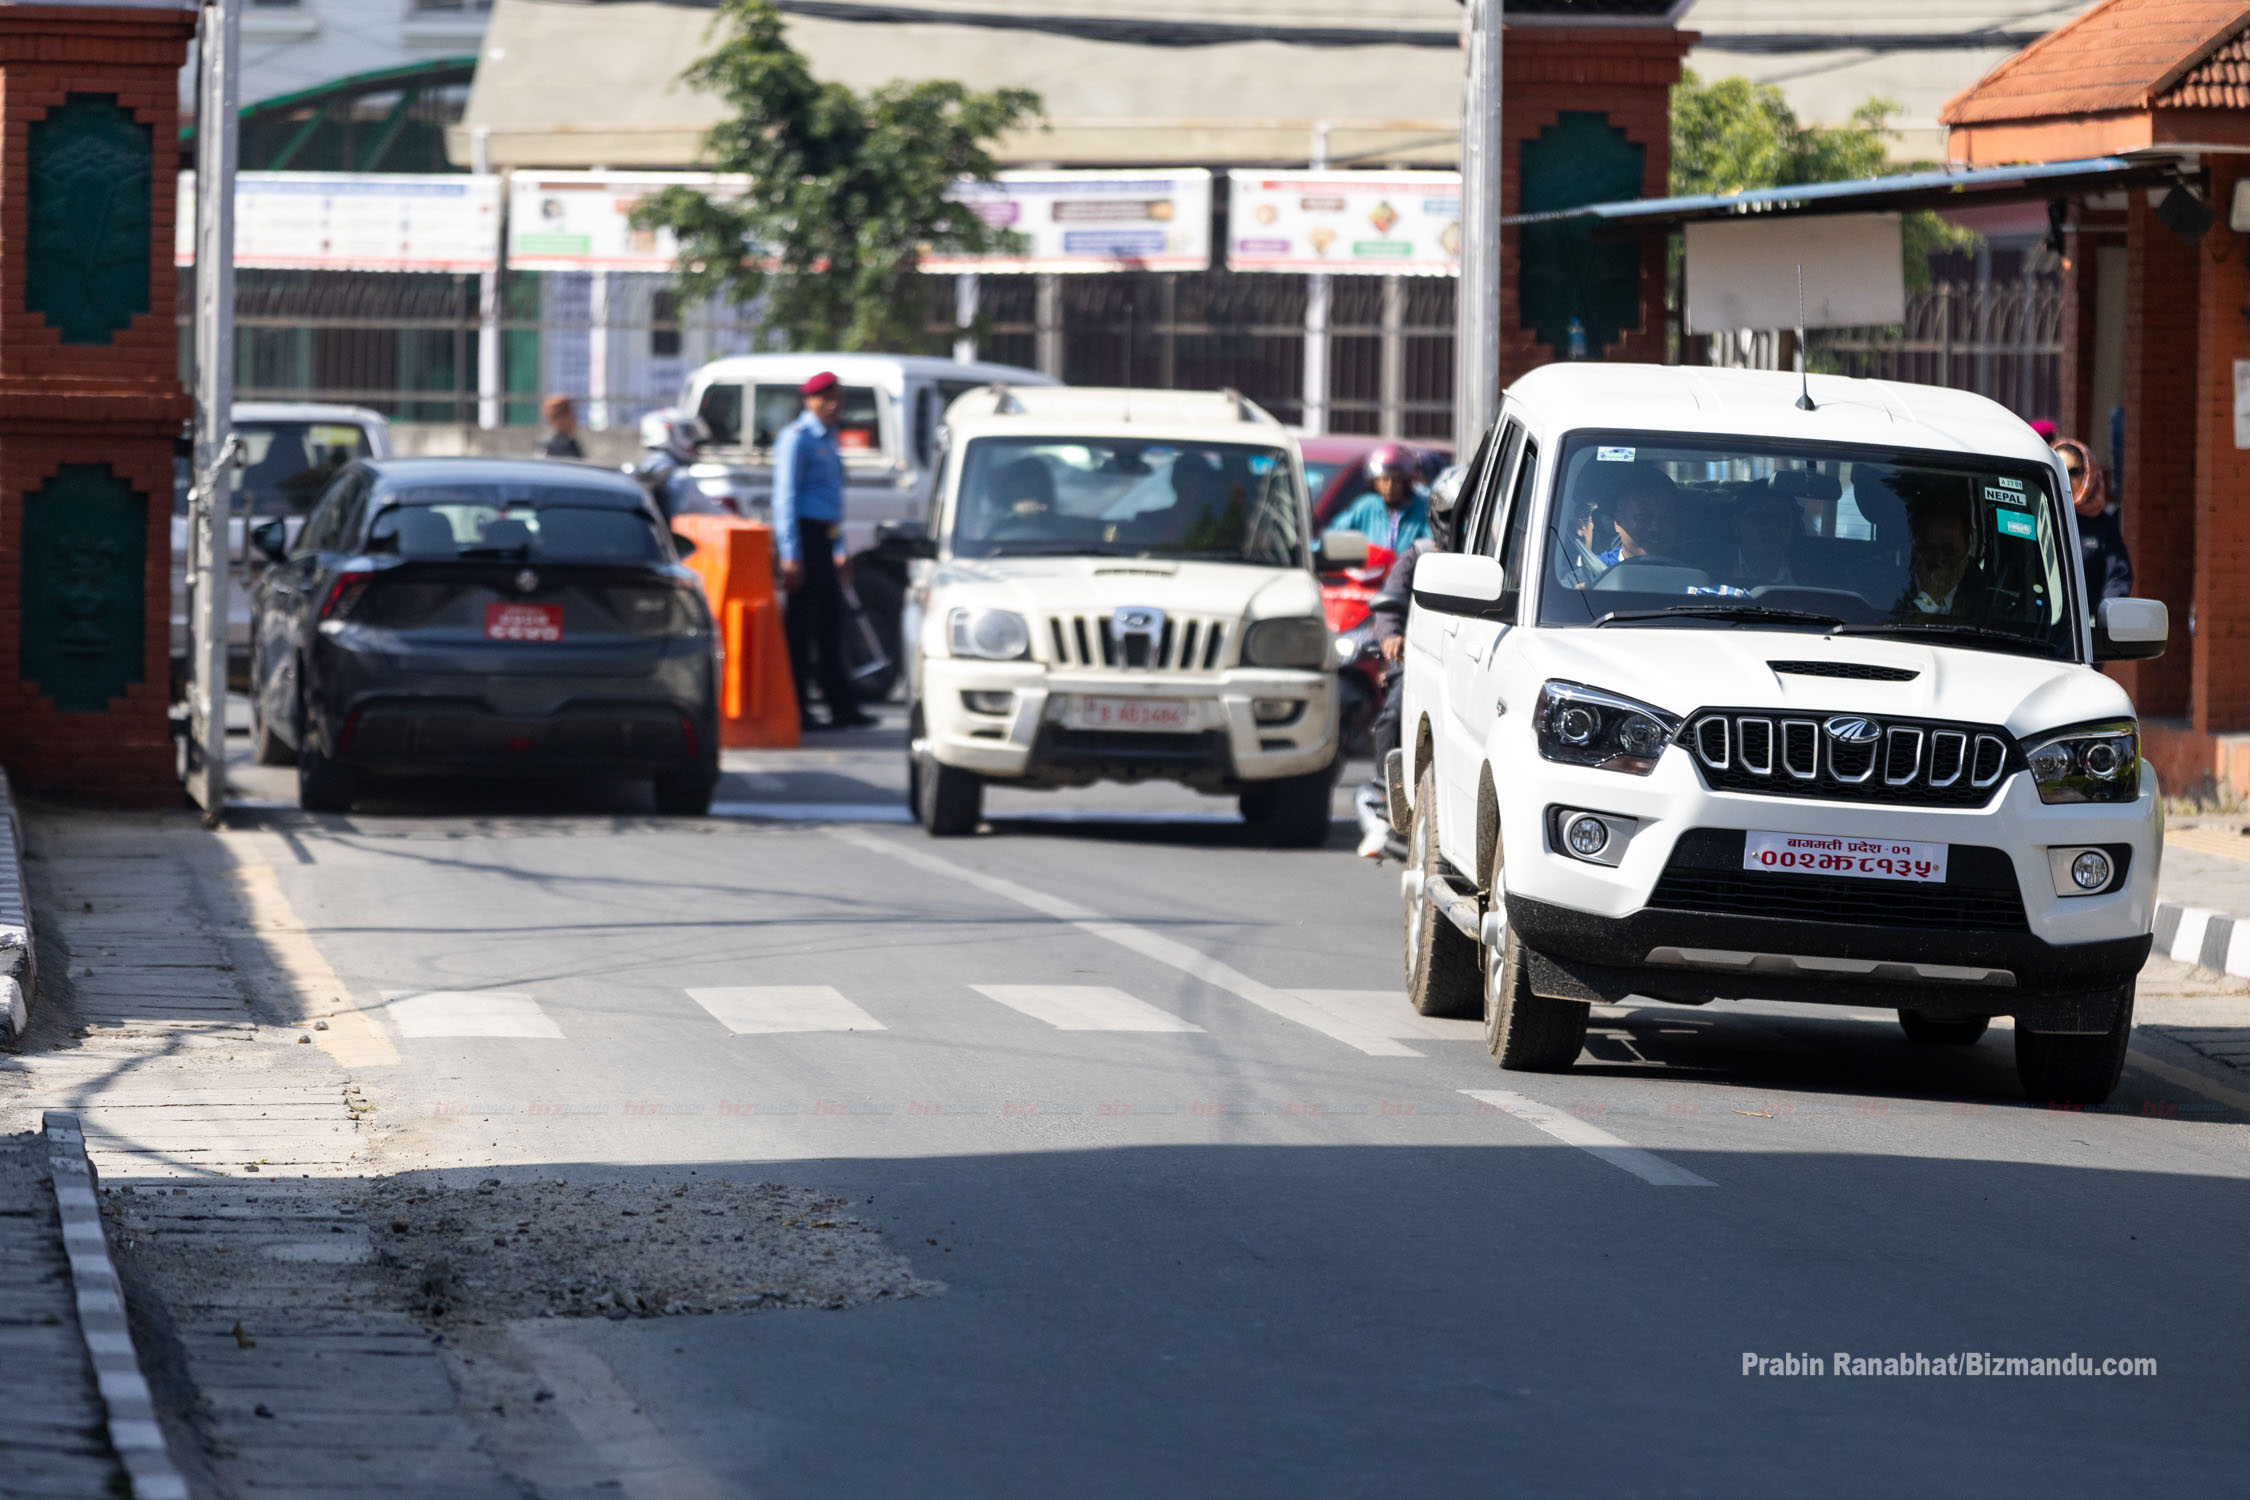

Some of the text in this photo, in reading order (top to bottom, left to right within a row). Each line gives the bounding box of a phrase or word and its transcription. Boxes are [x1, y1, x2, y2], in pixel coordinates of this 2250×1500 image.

[1986, 489, 2024, 505] NEPAL
[1787, 838, 1842, 851] बागमती
[1848, 841, 1882, 854] प्रदेश
